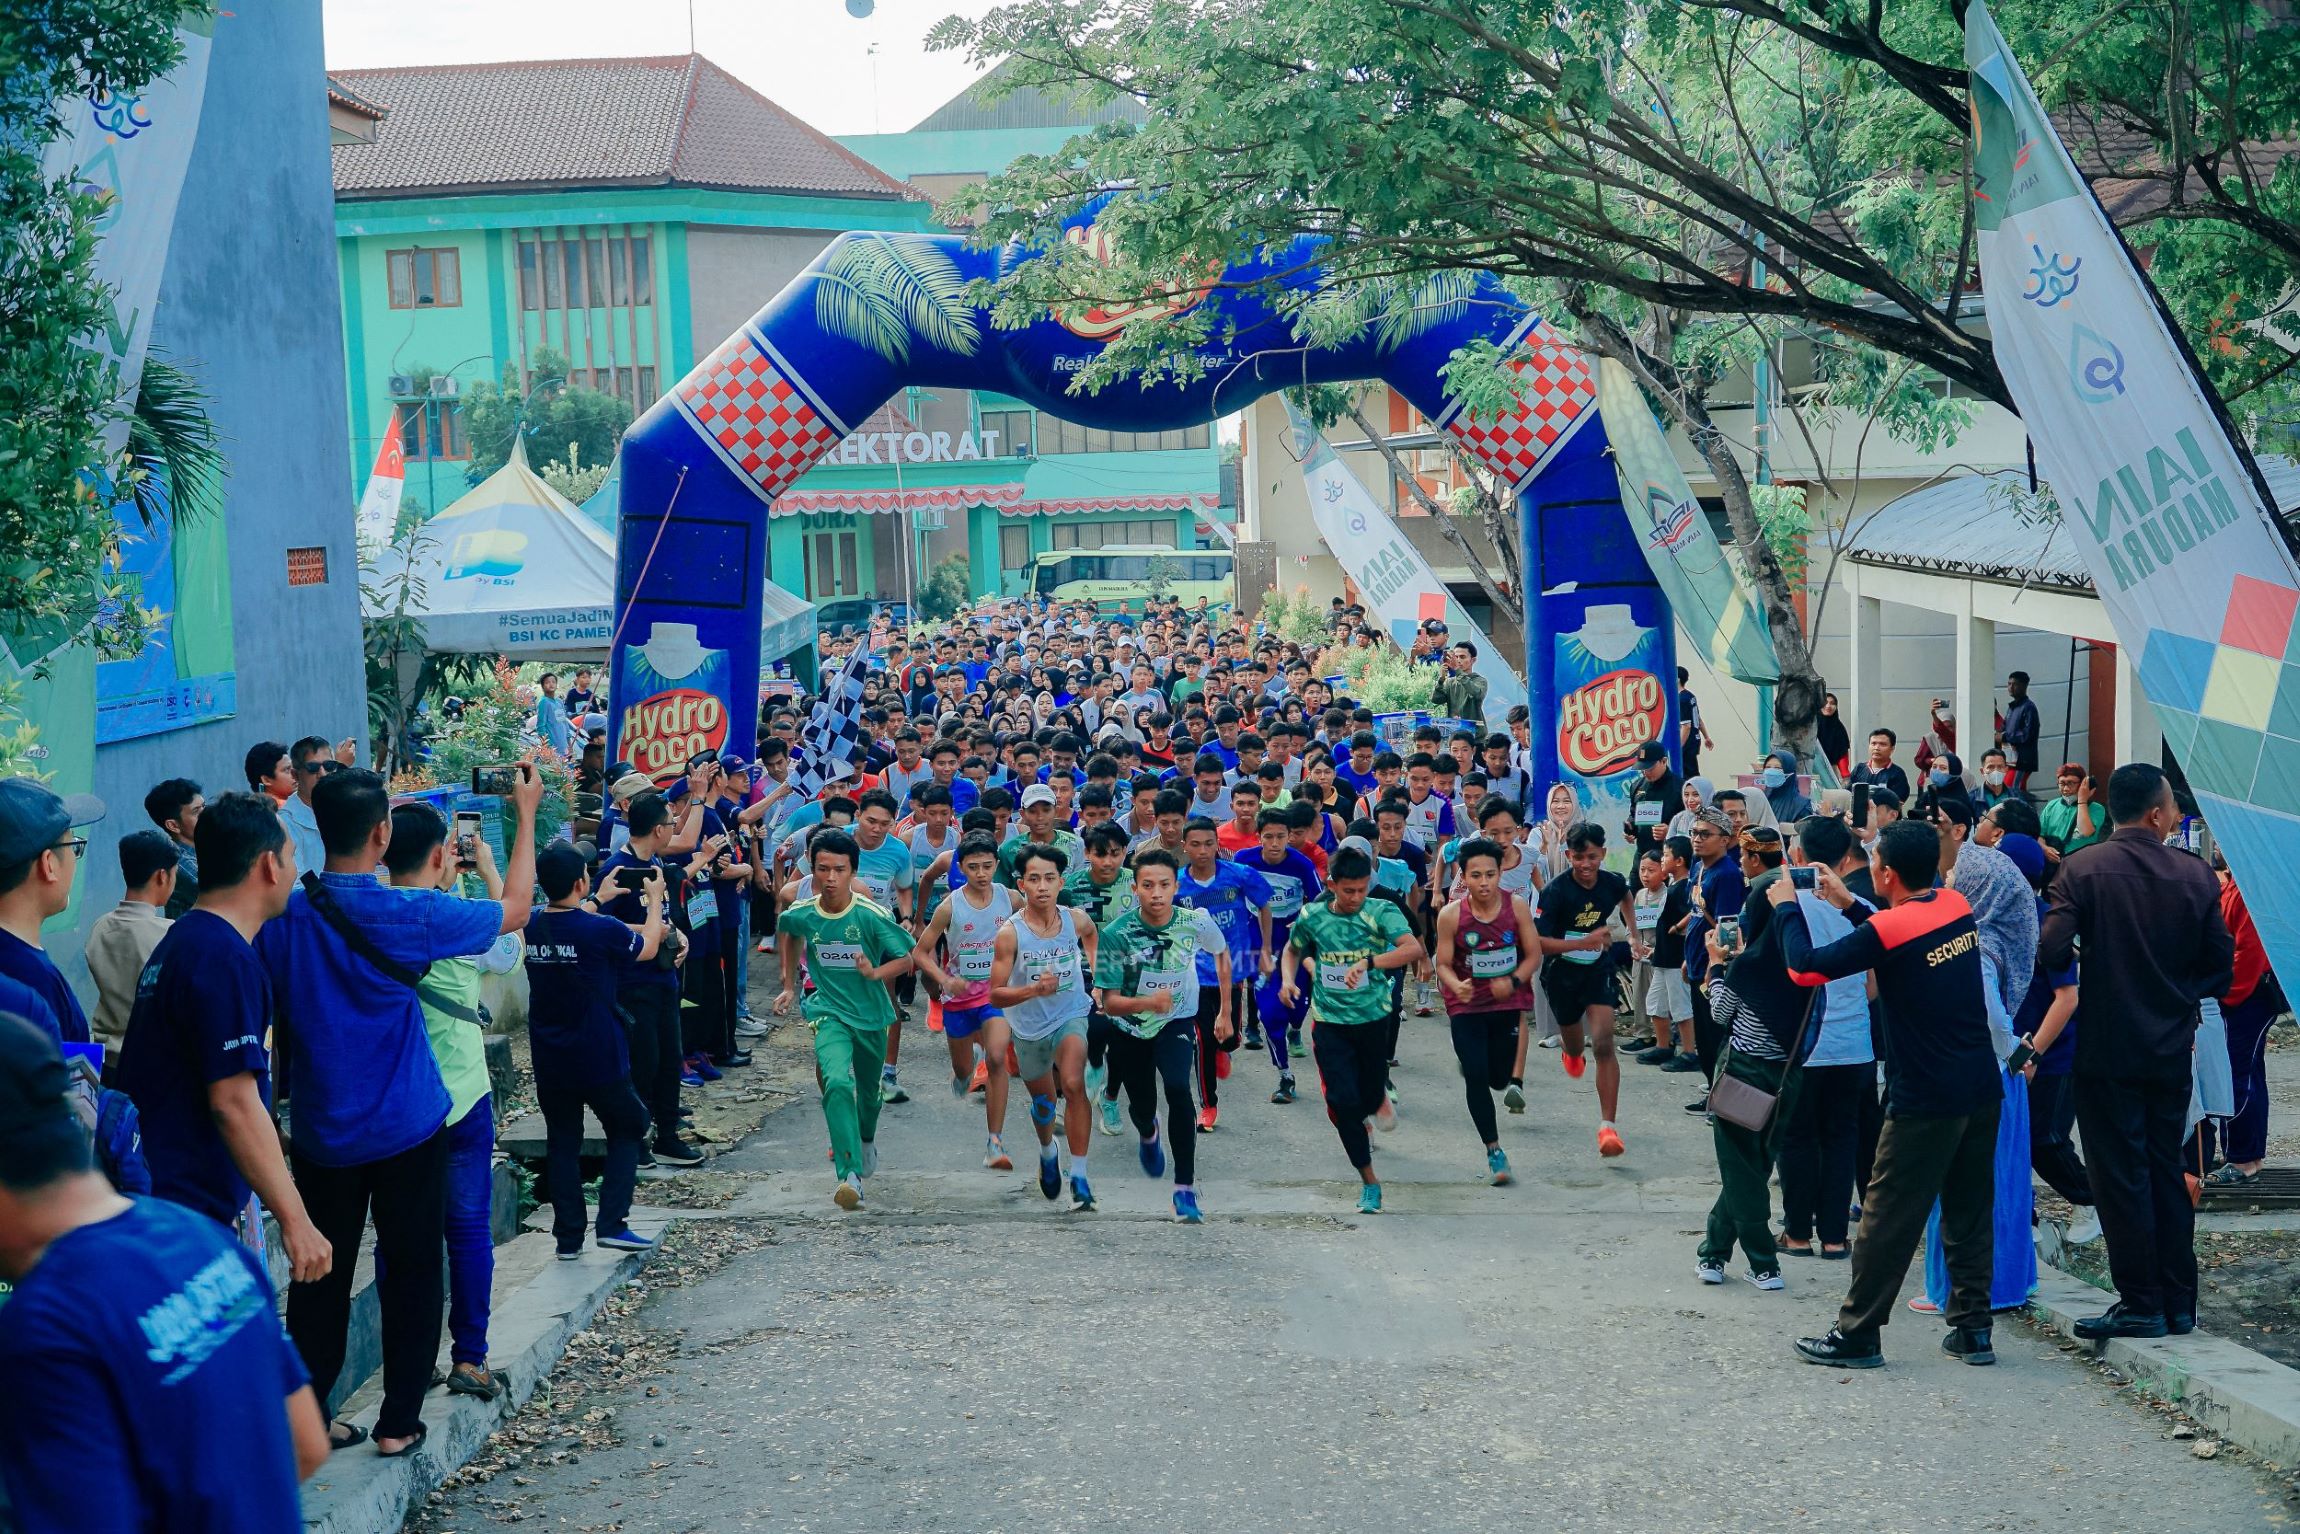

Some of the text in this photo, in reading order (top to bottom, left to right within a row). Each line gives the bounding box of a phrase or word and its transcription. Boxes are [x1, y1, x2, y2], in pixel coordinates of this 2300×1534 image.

[493, 577, 515, 586] BSI
[509, 631, 534, 643] BSI
[540, 629, 561, 641] KC
[624, 694, 722, 742] Hydro
[1562, 674, 1659, 730] Hydro
[625, 731, 708, 774] Coco
[1570, 712, 1652, 772] Coco
[1926, 928, 1979, 967] SECURITY
[1031, 970, 1072, 982] 079
